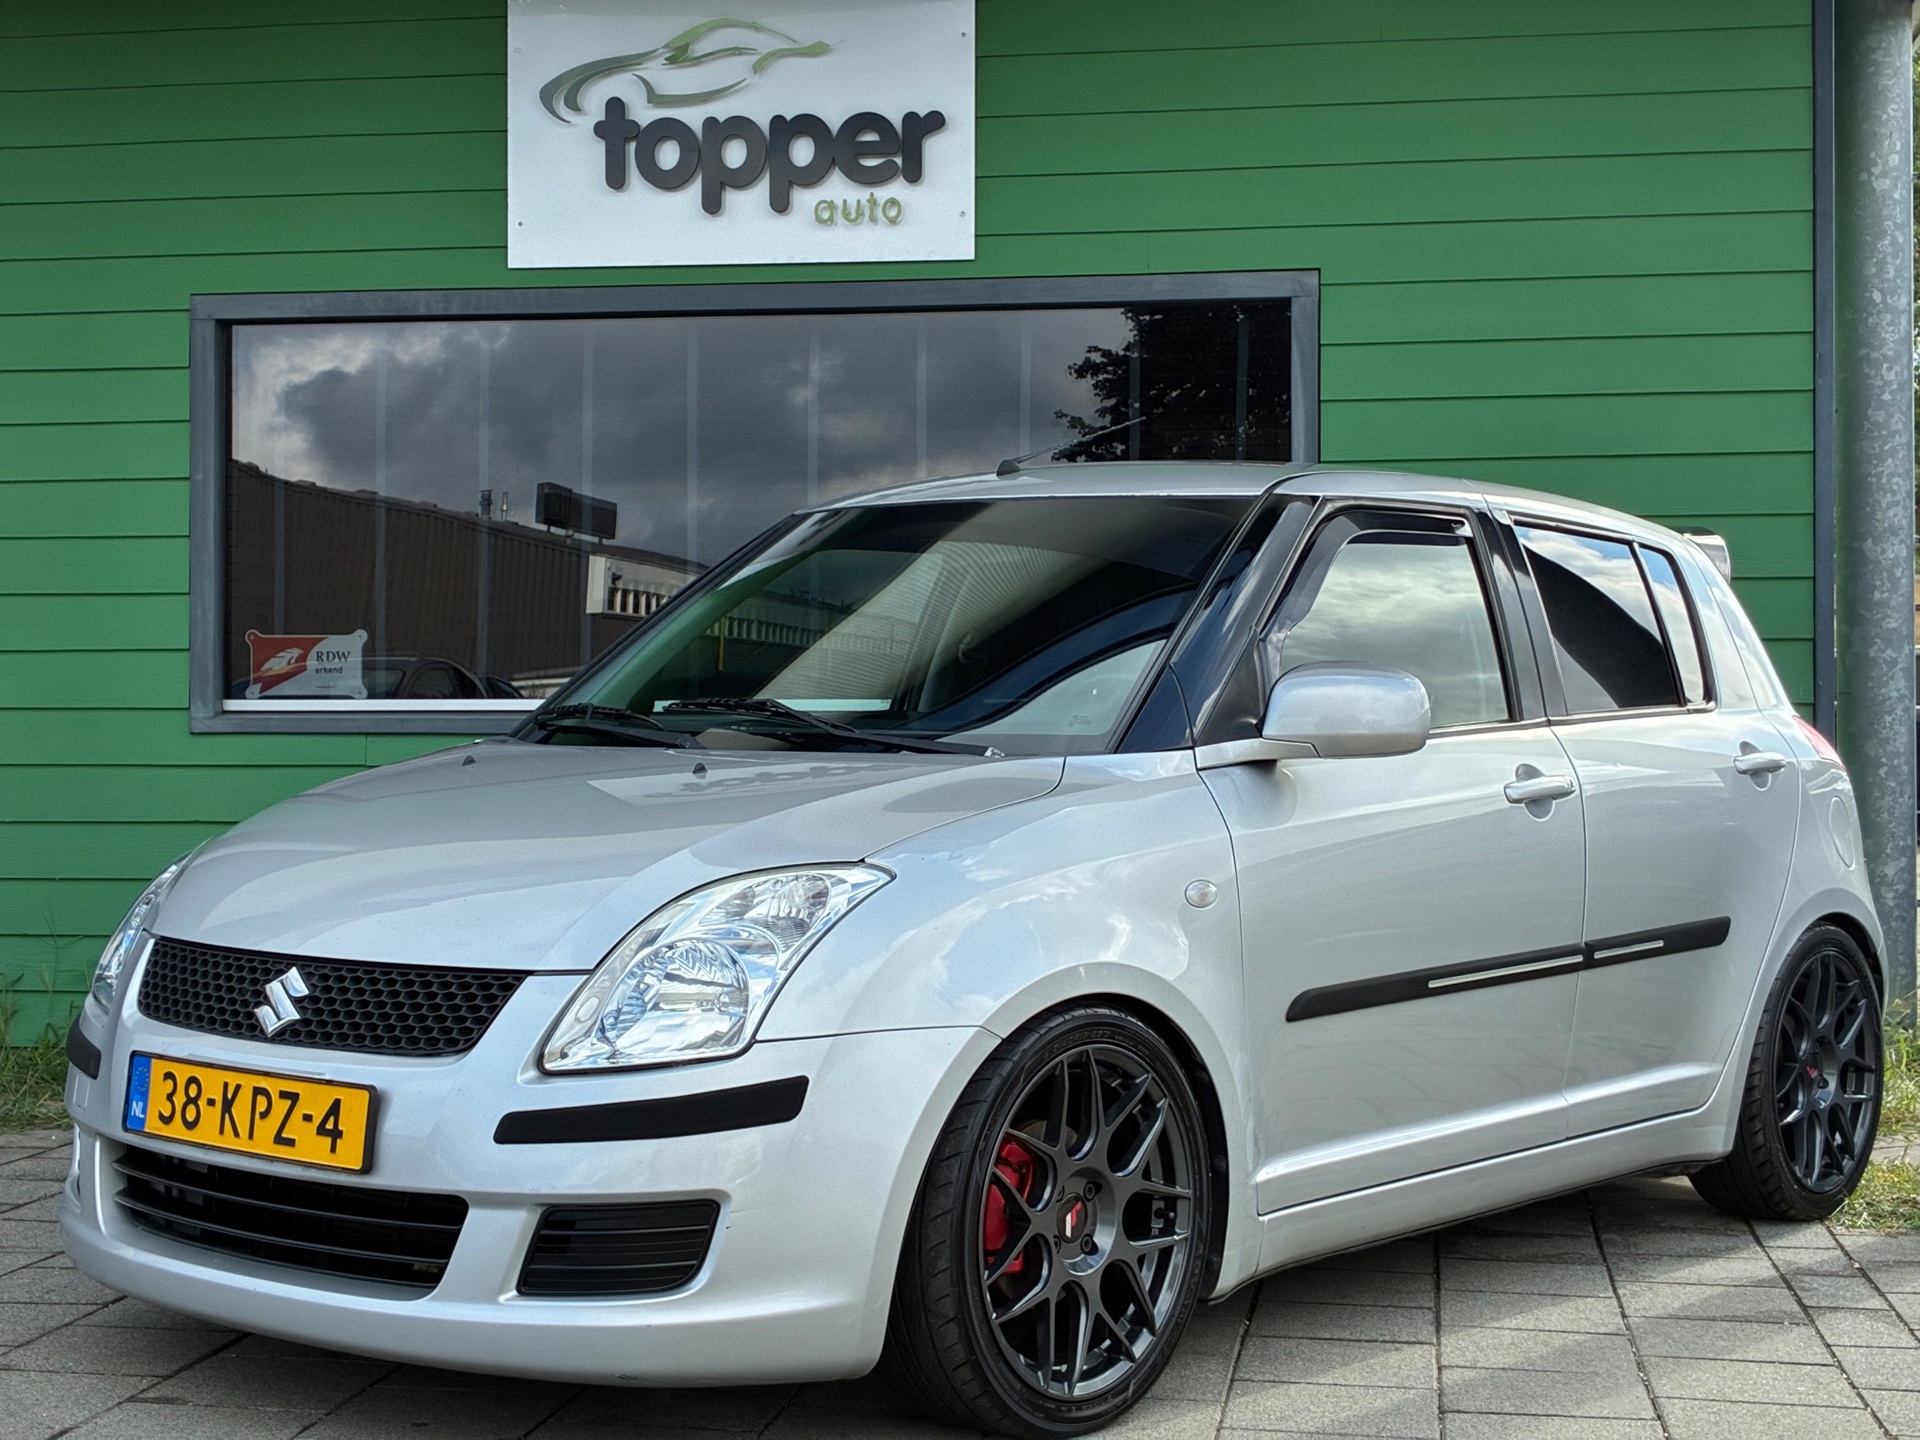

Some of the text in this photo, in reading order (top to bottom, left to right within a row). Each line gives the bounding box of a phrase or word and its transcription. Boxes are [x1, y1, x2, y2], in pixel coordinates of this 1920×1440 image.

[594, 96, 946, 215] topper
[814, 192, 902, 226] auto
[315, 650, 351, 662] RDW
[315, 666, 343, 674] erkend
[131, 1100, 145, 1118] NL
[158, 1070, 344, 1154] 38-KPZ-4
